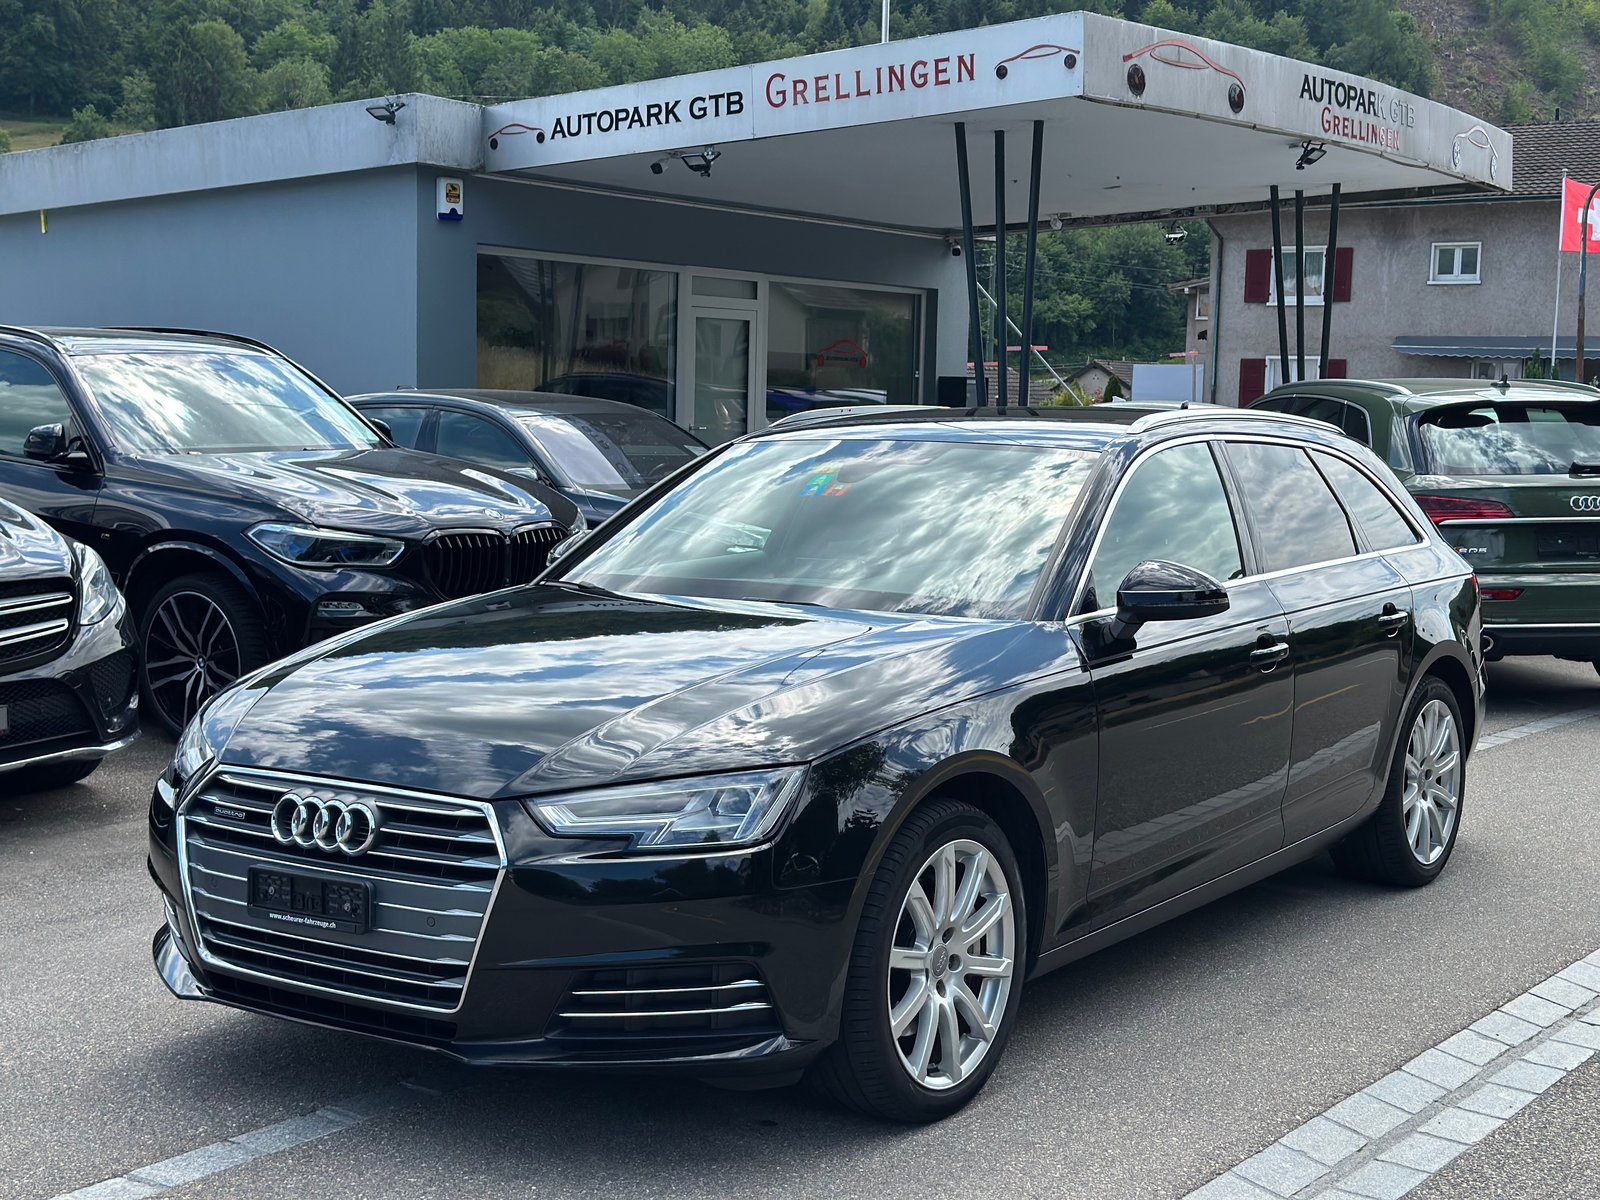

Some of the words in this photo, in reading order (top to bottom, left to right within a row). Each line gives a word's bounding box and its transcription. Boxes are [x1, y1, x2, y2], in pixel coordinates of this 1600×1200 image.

[766, 53, 975, 108] GRELLINGEN
[1299, 74, 1387, 120] AUTOPARK
[550, 99, 682, 140] AUTOPARK
[689, 91, 744, 120] GTB
[1321, 106, 1400, 151] GRELLINGEN
